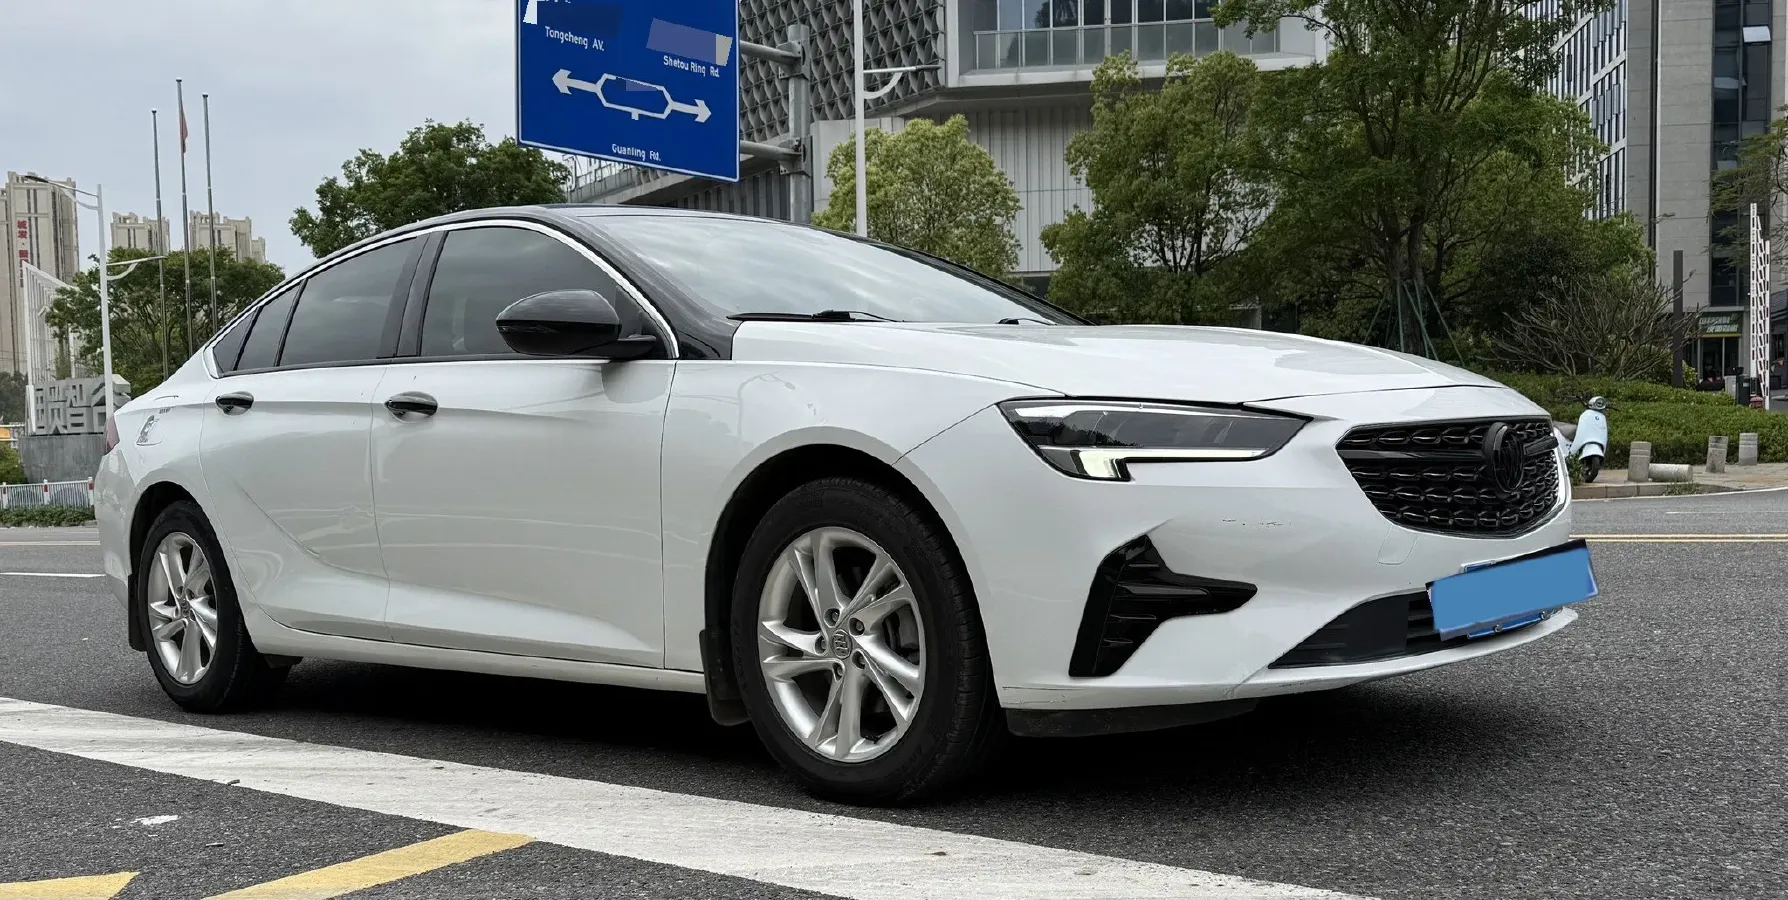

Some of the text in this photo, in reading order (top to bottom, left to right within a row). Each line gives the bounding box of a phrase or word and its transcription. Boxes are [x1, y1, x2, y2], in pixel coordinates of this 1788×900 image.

[544, 25, 588, 50] Tongcheng
[663, 54, 689, 71] Shetou
[690, 61, 706, 77] Ring
